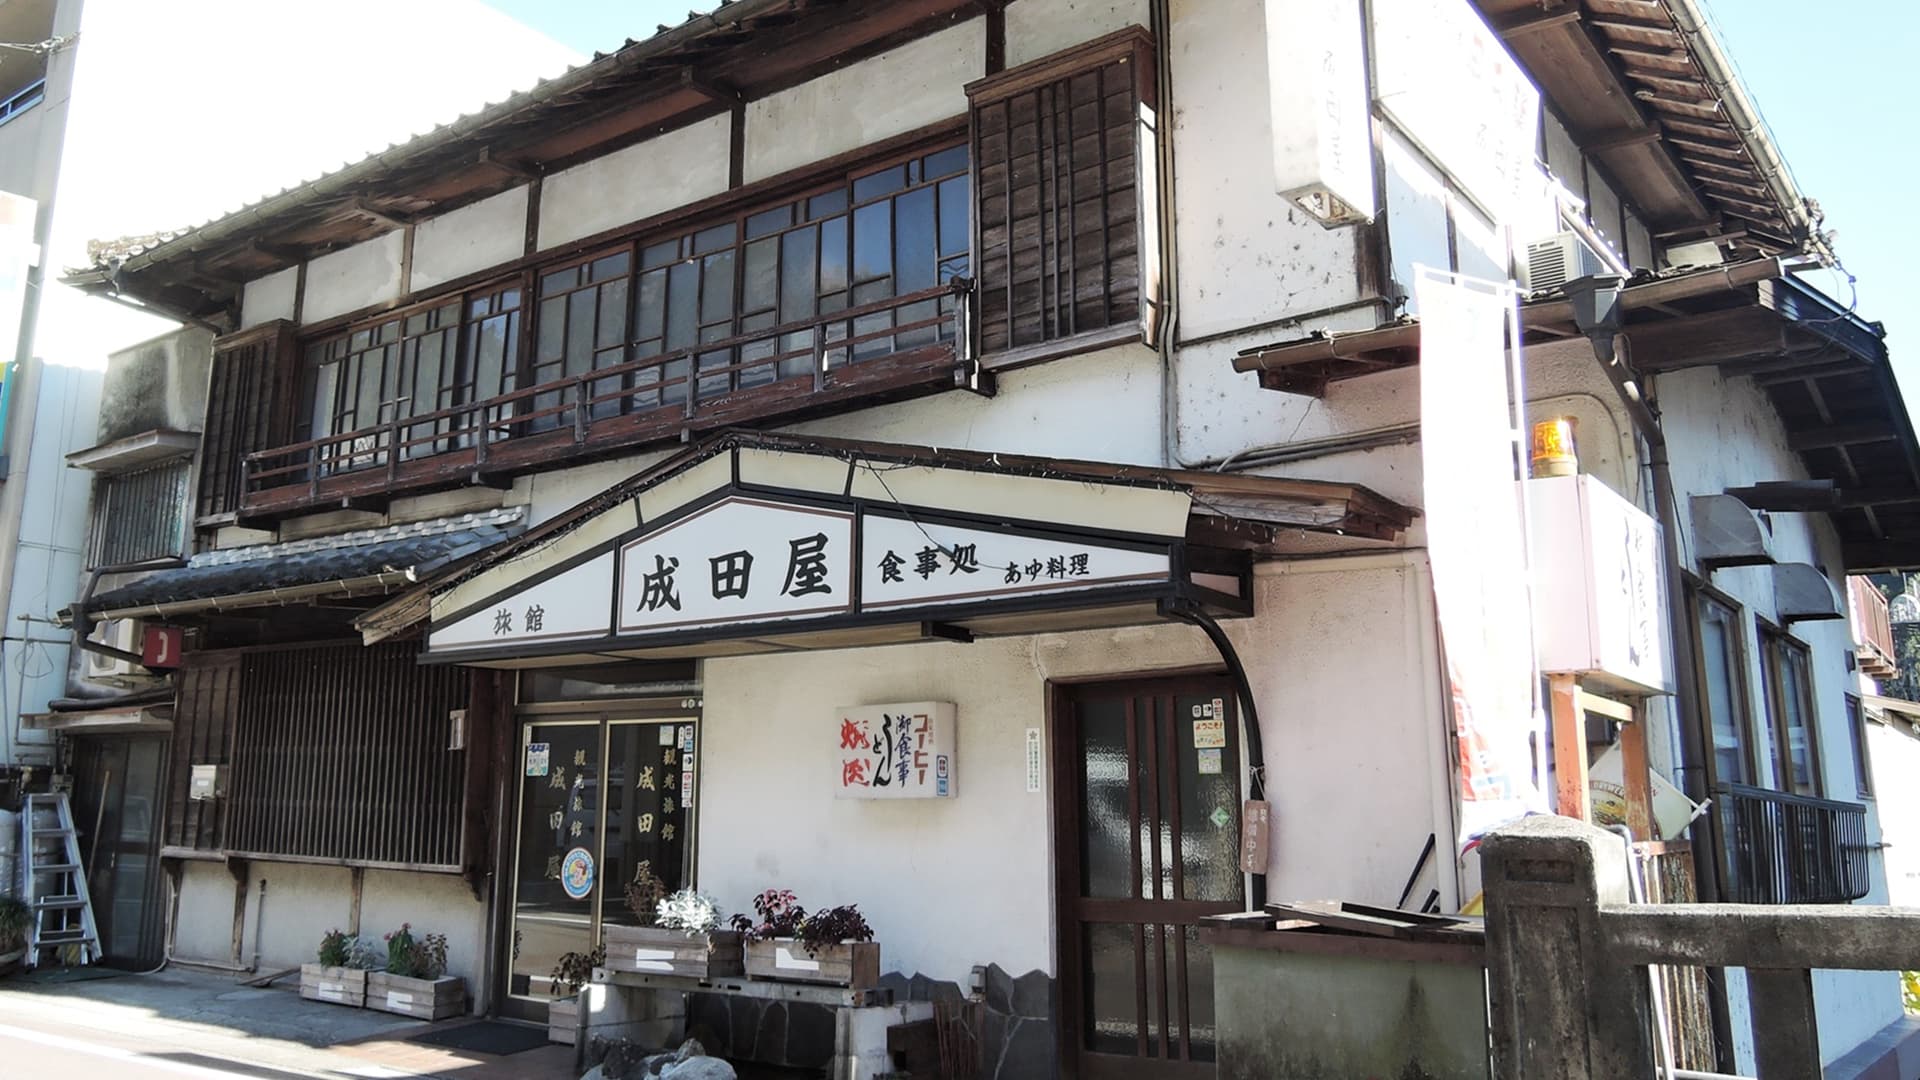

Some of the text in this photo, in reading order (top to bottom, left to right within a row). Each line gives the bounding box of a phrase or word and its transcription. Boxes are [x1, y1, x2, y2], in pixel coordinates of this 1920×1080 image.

[637, 532, 832, 612] 成田屋
[877, 544, 979, 584] 食事処
[1004, 553, 1090, 584] あゆ料理
[493, 605, 545, 635] 旅館
[873, 714, 892, 786] うどん
[895, 715, 912, 787] 御食事
[914, 714, 928, 785] コーヒー
